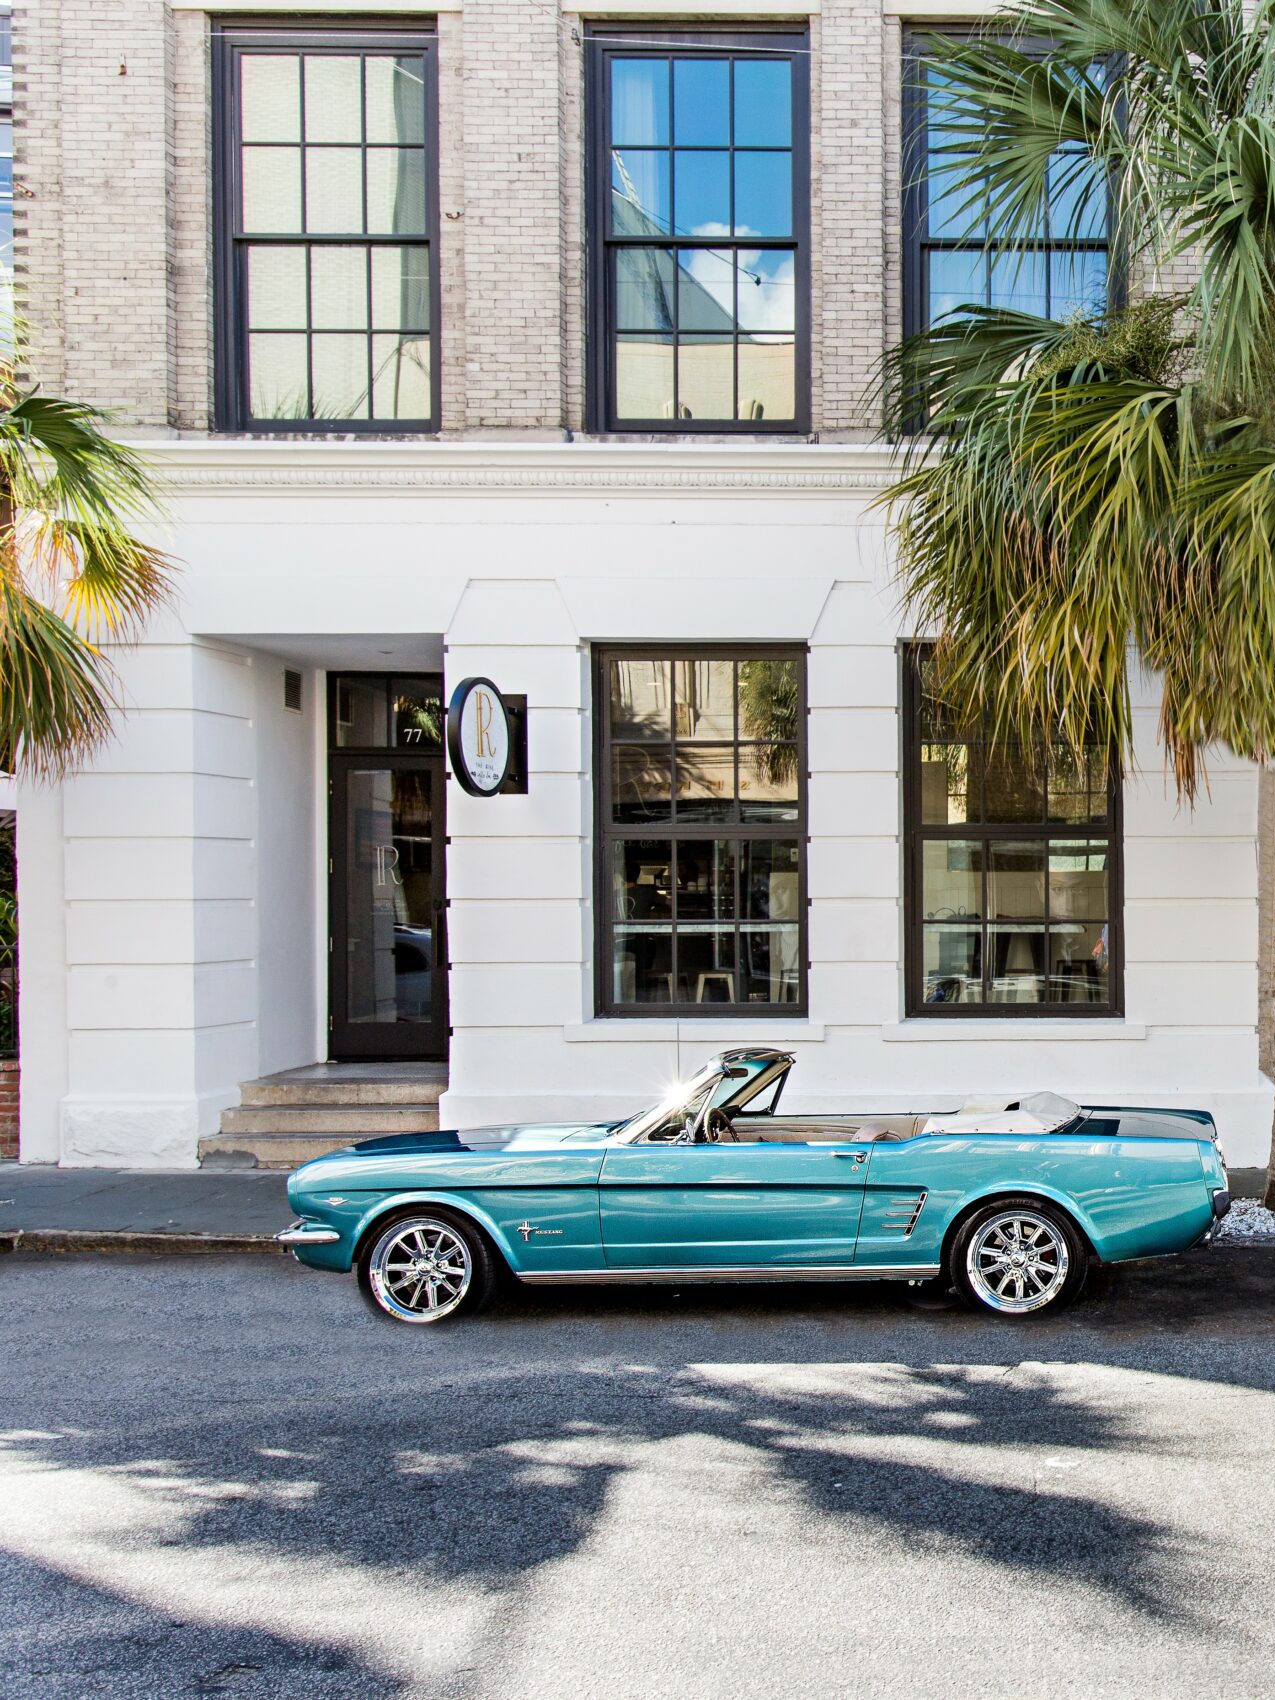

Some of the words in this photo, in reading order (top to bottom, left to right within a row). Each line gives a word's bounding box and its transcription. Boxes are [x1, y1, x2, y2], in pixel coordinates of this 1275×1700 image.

[403, 728, 422, 743] 77
[475, 690, 497, 757] R
[375, 845, 404, 886] R
